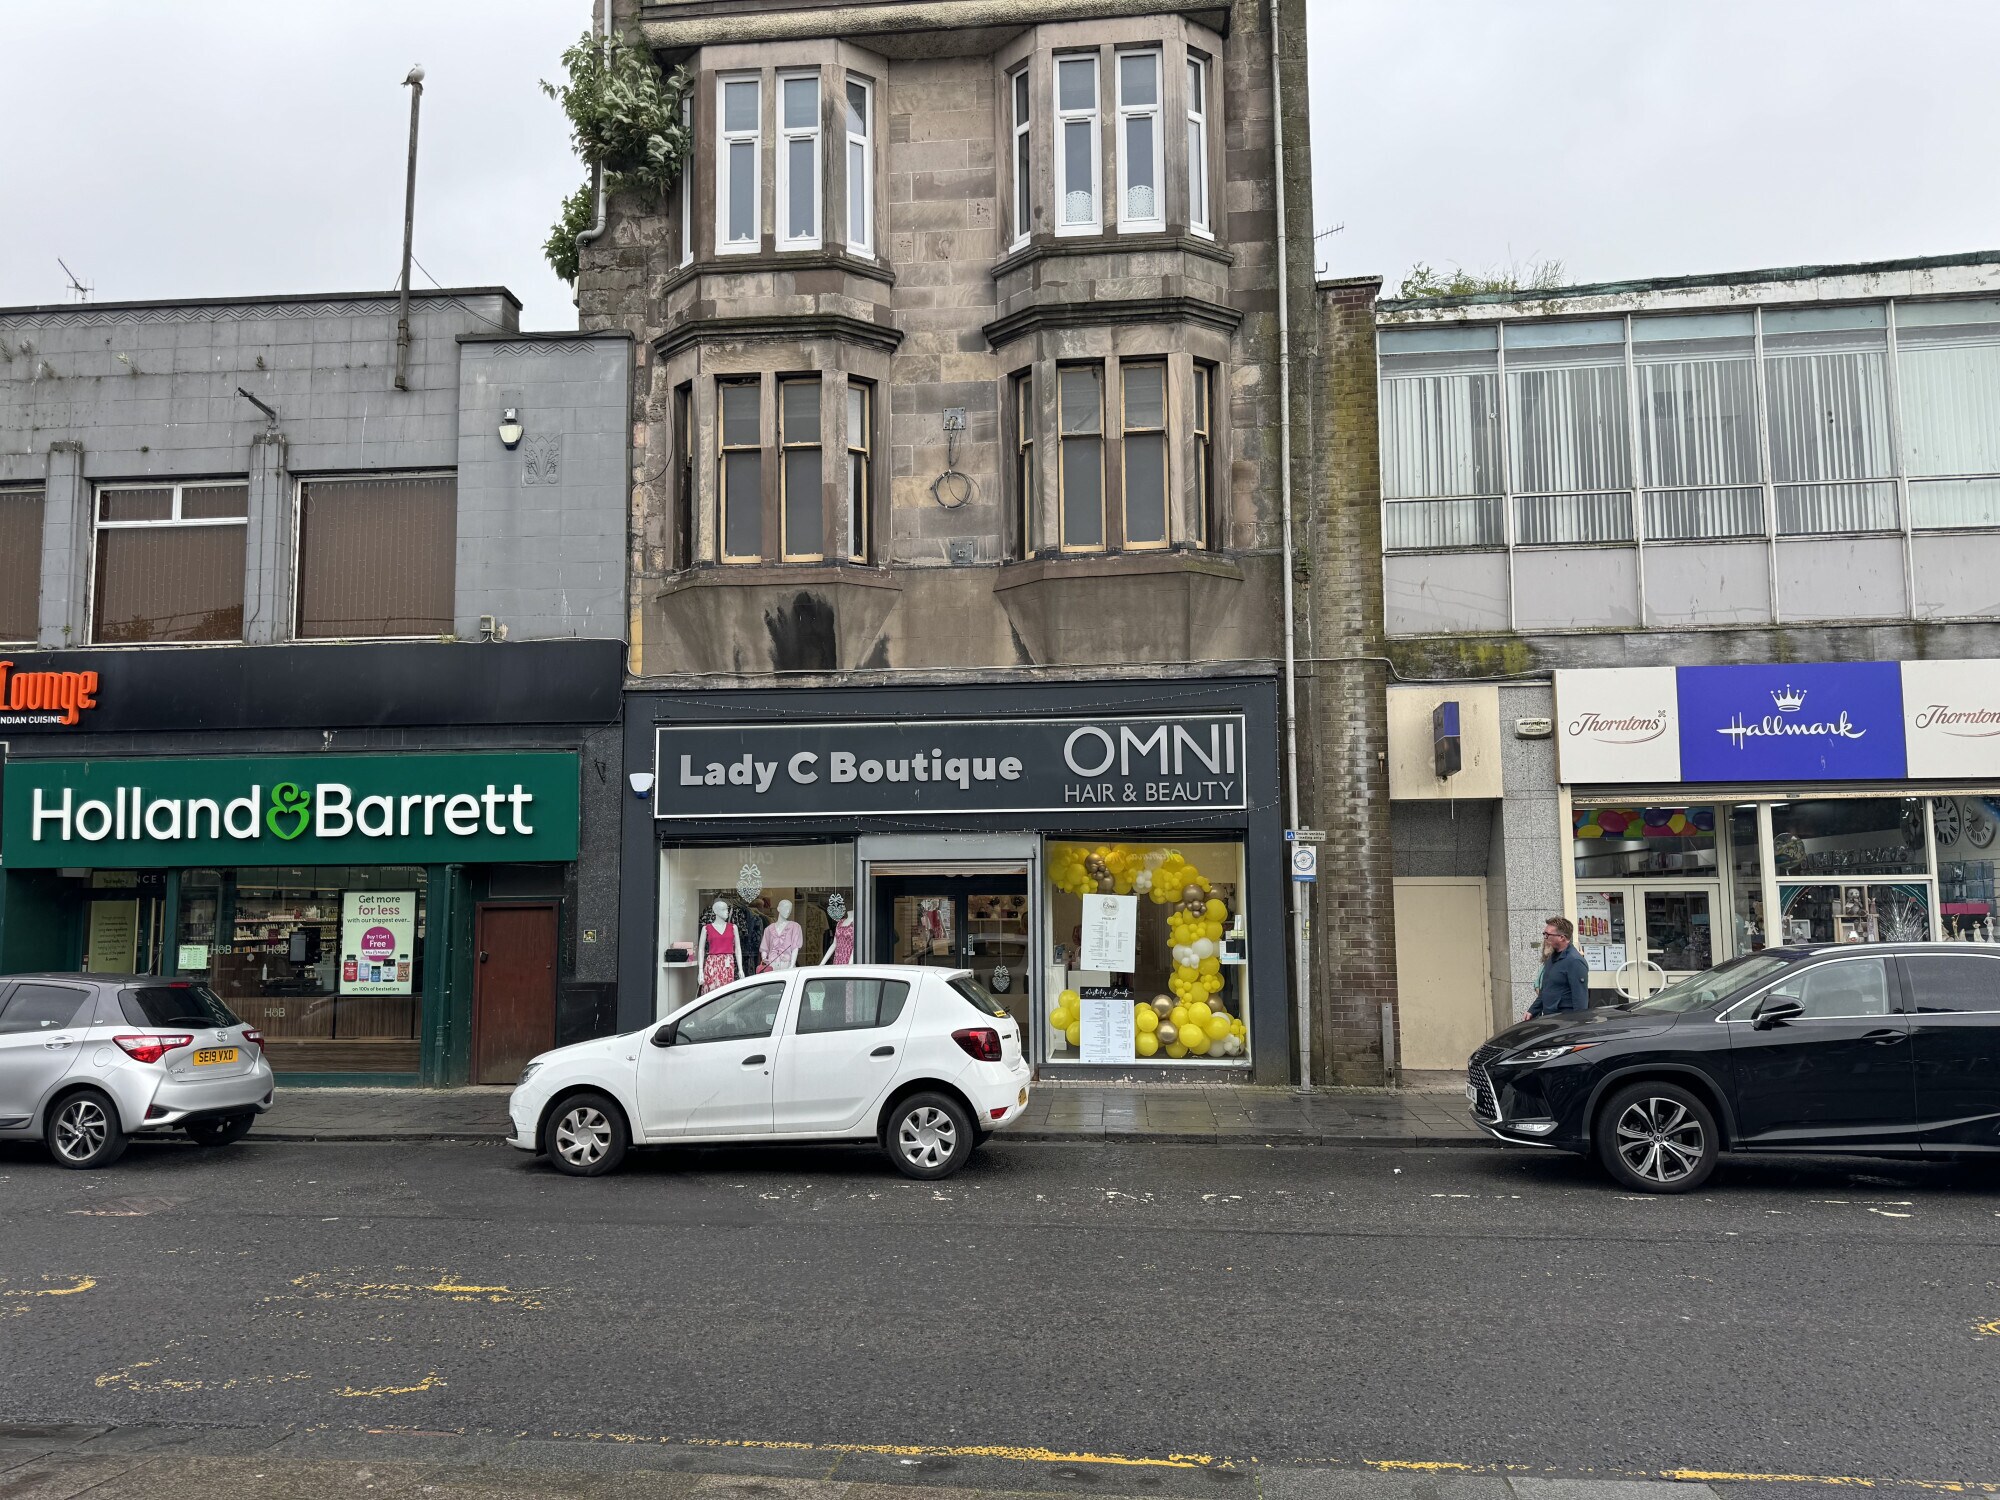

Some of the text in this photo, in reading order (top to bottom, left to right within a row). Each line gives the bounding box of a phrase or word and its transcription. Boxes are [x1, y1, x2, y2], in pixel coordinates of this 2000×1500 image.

[0, 661, 98, 725] Lounge
[0, 715, 61, 724] NDIAN CUISINE
[1568, 711, 1663, 737] Thorntons
[1915, 704, 2000, 729] Thornton
[1716, 710, 1866, 750] Hallmark
[1063, 723, 1235, 777] OMNI
[680, 748, 1023, 793] Lady C Boutique
[1064, 780, 1235, 802] HAIR & BEAUTY
[32, 782, 534, 842] Holland & Barrett
[358, 895, 401, 904] Get more
[358, 905, 400, 916] for less
[369, 940, 387, 948] Free
[198, 1050, 234, 1063] SE19 VXD
